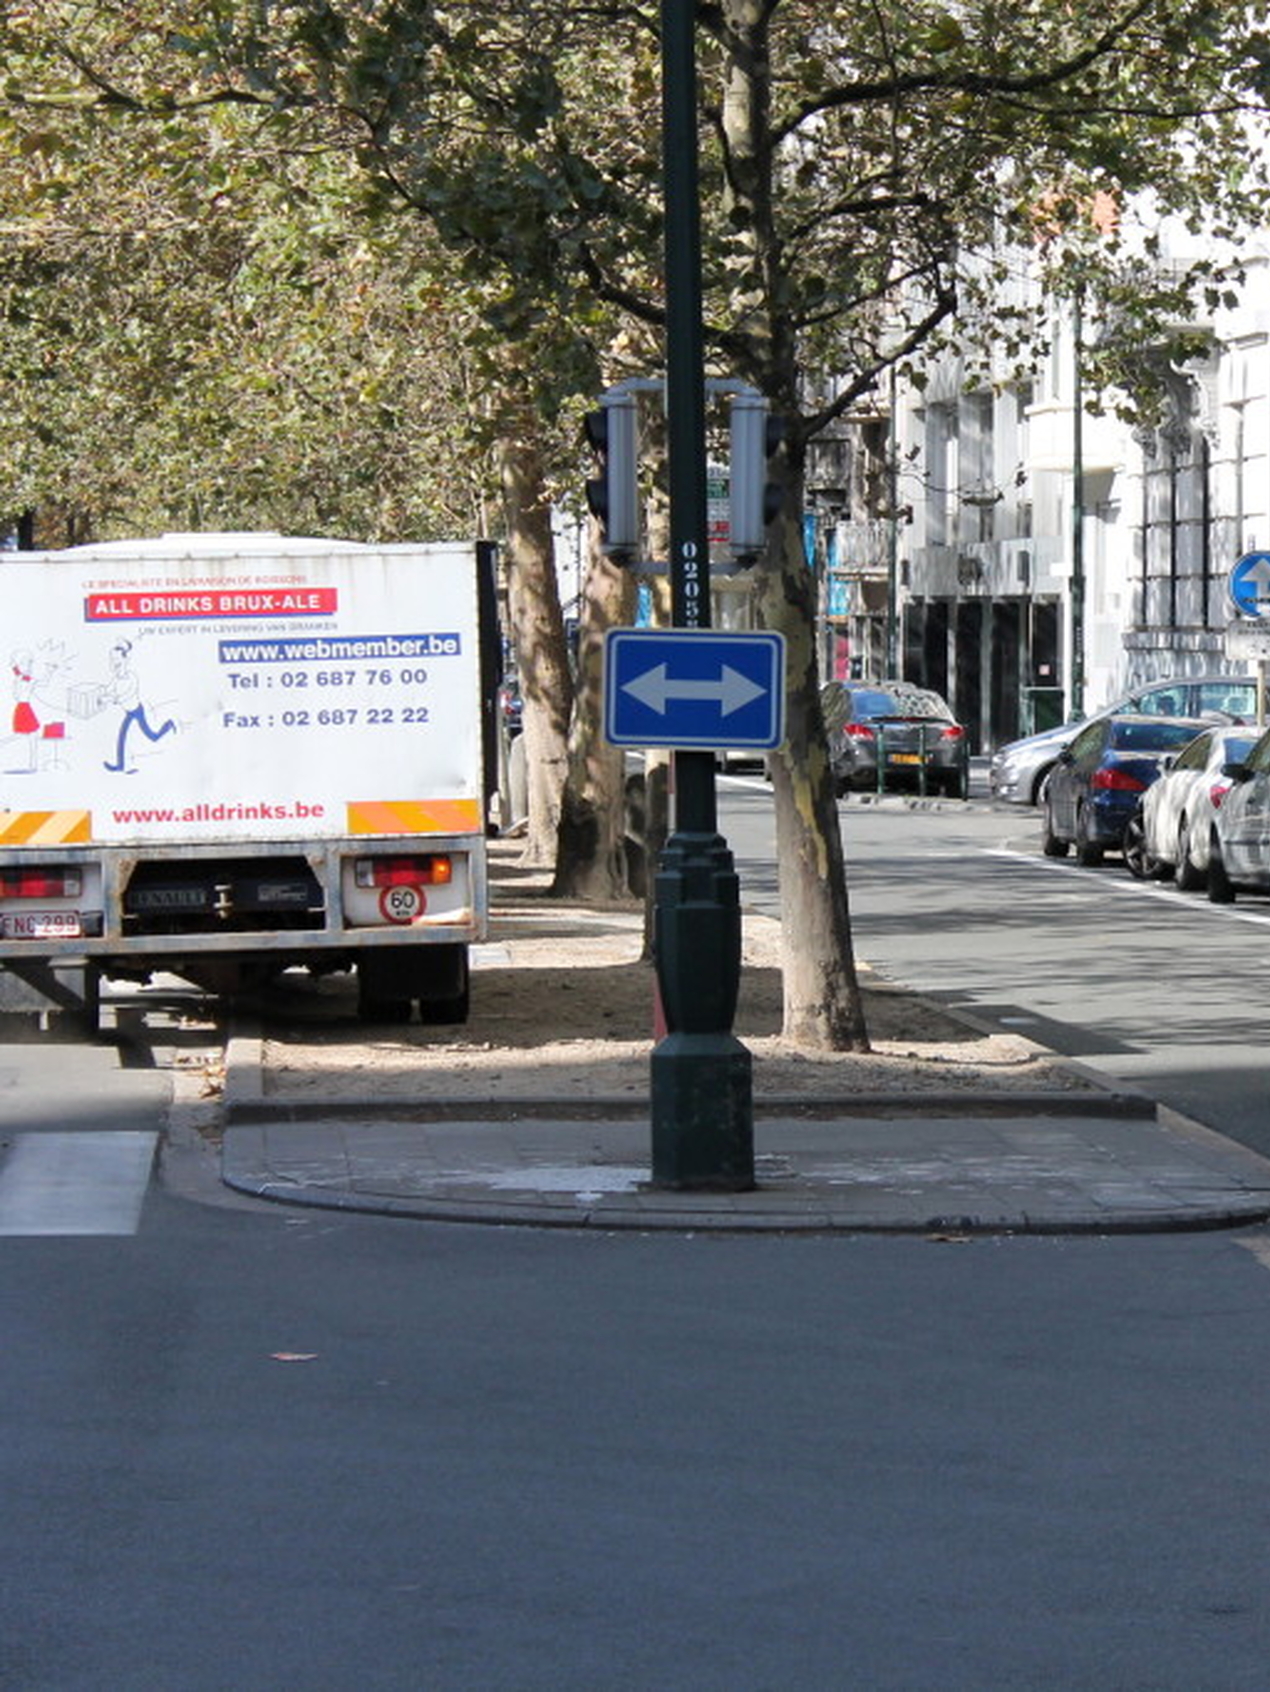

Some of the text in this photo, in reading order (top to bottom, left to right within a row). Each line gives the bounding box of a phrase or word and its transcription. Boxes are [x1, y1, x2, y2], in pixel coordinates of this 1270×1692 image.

[95, 594, 321, 614] ALL DRINKS BRUX-ALE
[223, 635, 459, 661] www.webmember.be
[227, 673, 259, 689] Tel
[280, 671, 309, 688] 02
[316, 670, 356, 687] 687
[365, 669, 392, 685] 76
[400, 668, 428, 684] 00
[223, 712, 261, 728] Fax
[282, 710, 310, 726] 02
[317, 709, 358, 725] 687
[366, 708, 394, 724] 22
[401, 707, 430, 723] 22
[112, 801, 325, 823] www.alldrinks.be
[391, 891, 415, 909] 60
